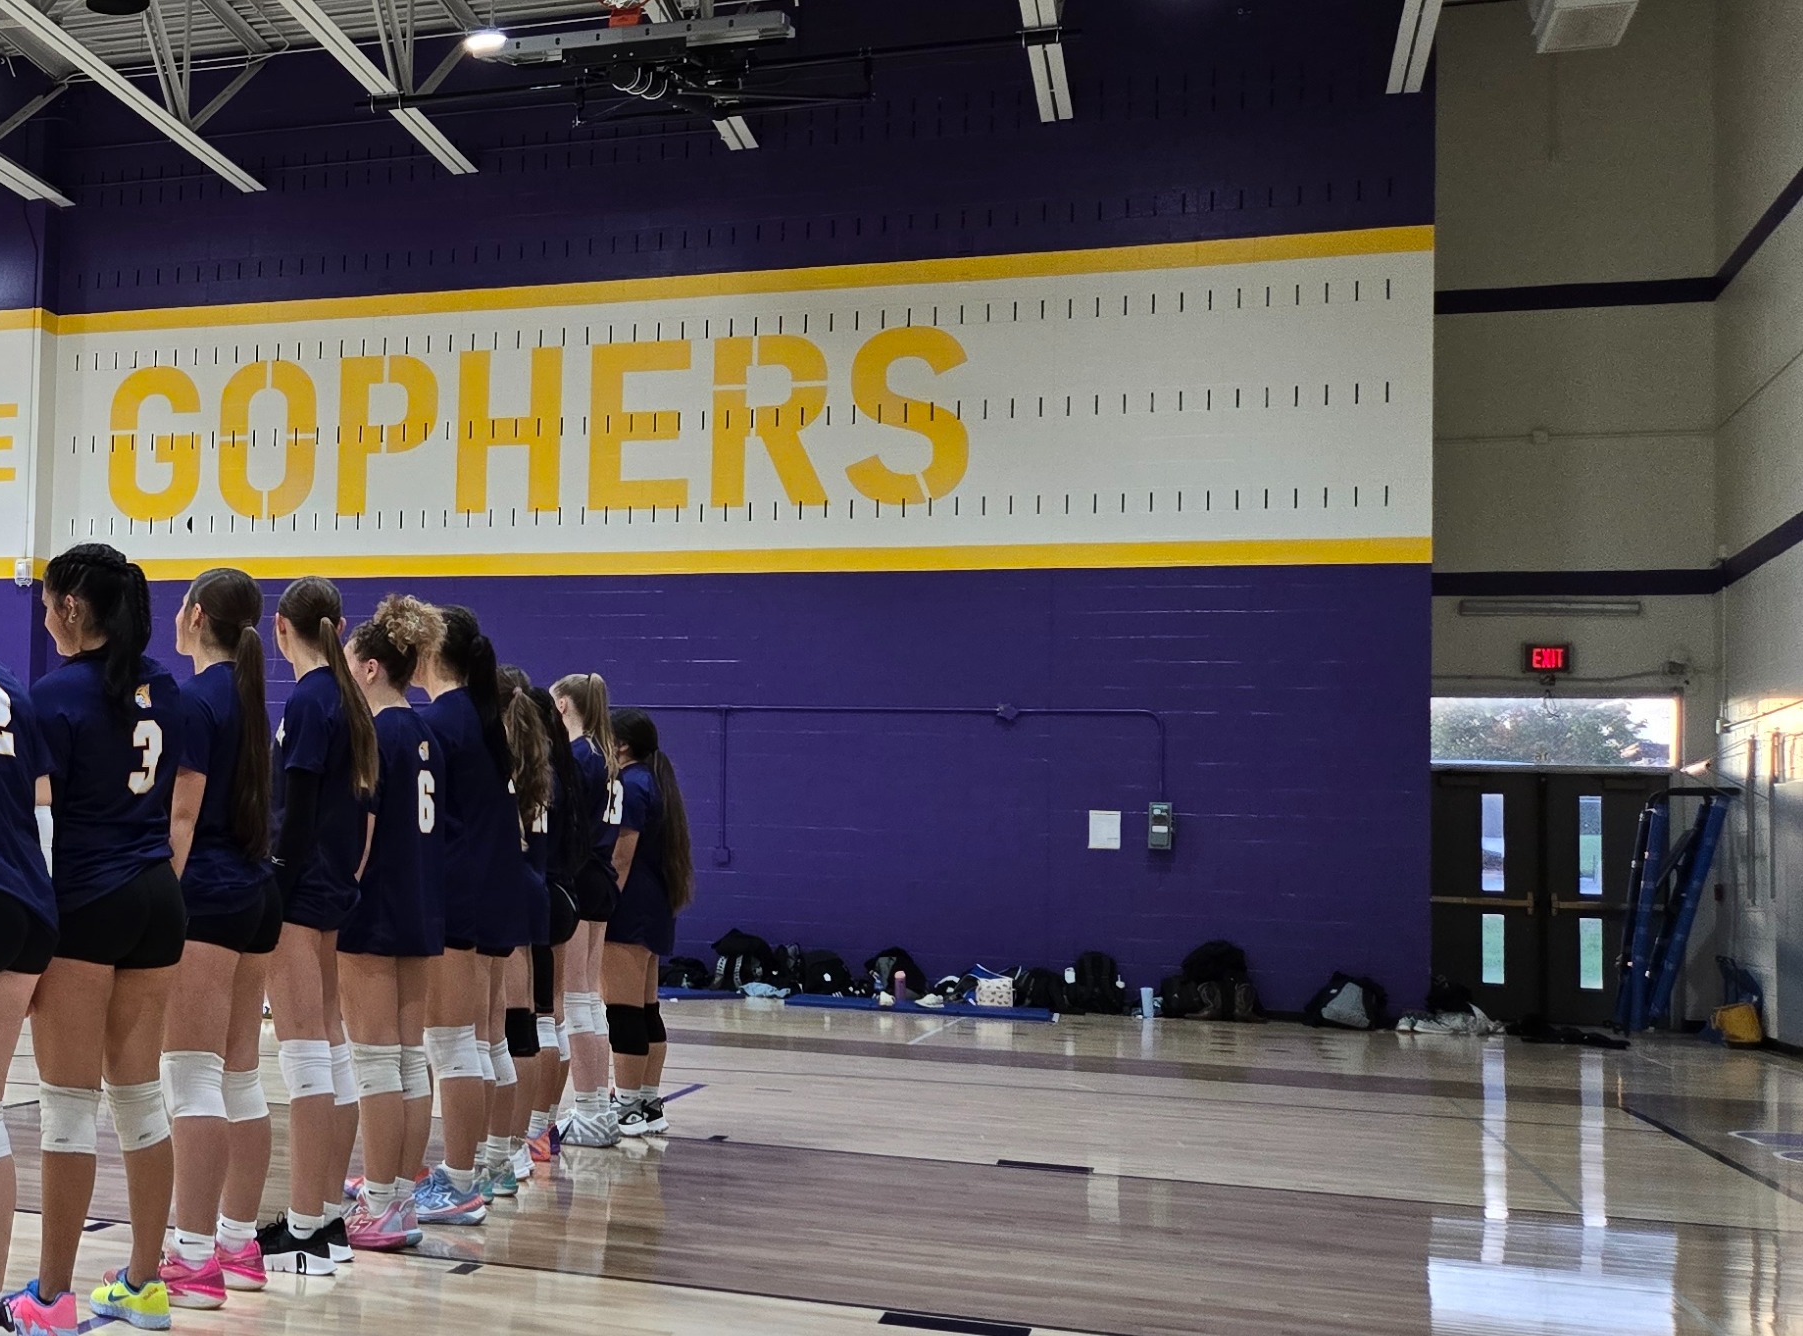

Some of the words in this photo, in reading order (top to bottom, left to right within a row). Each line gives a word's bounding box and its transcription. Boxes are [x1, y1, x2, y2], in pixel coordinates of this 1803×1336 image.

[107, 325, 970, 522] GOPHERS
[1532, 648, 1563, 668] EXIT
[127, 719, 163, 794] 3
[417, 769, 436, 834] 6
